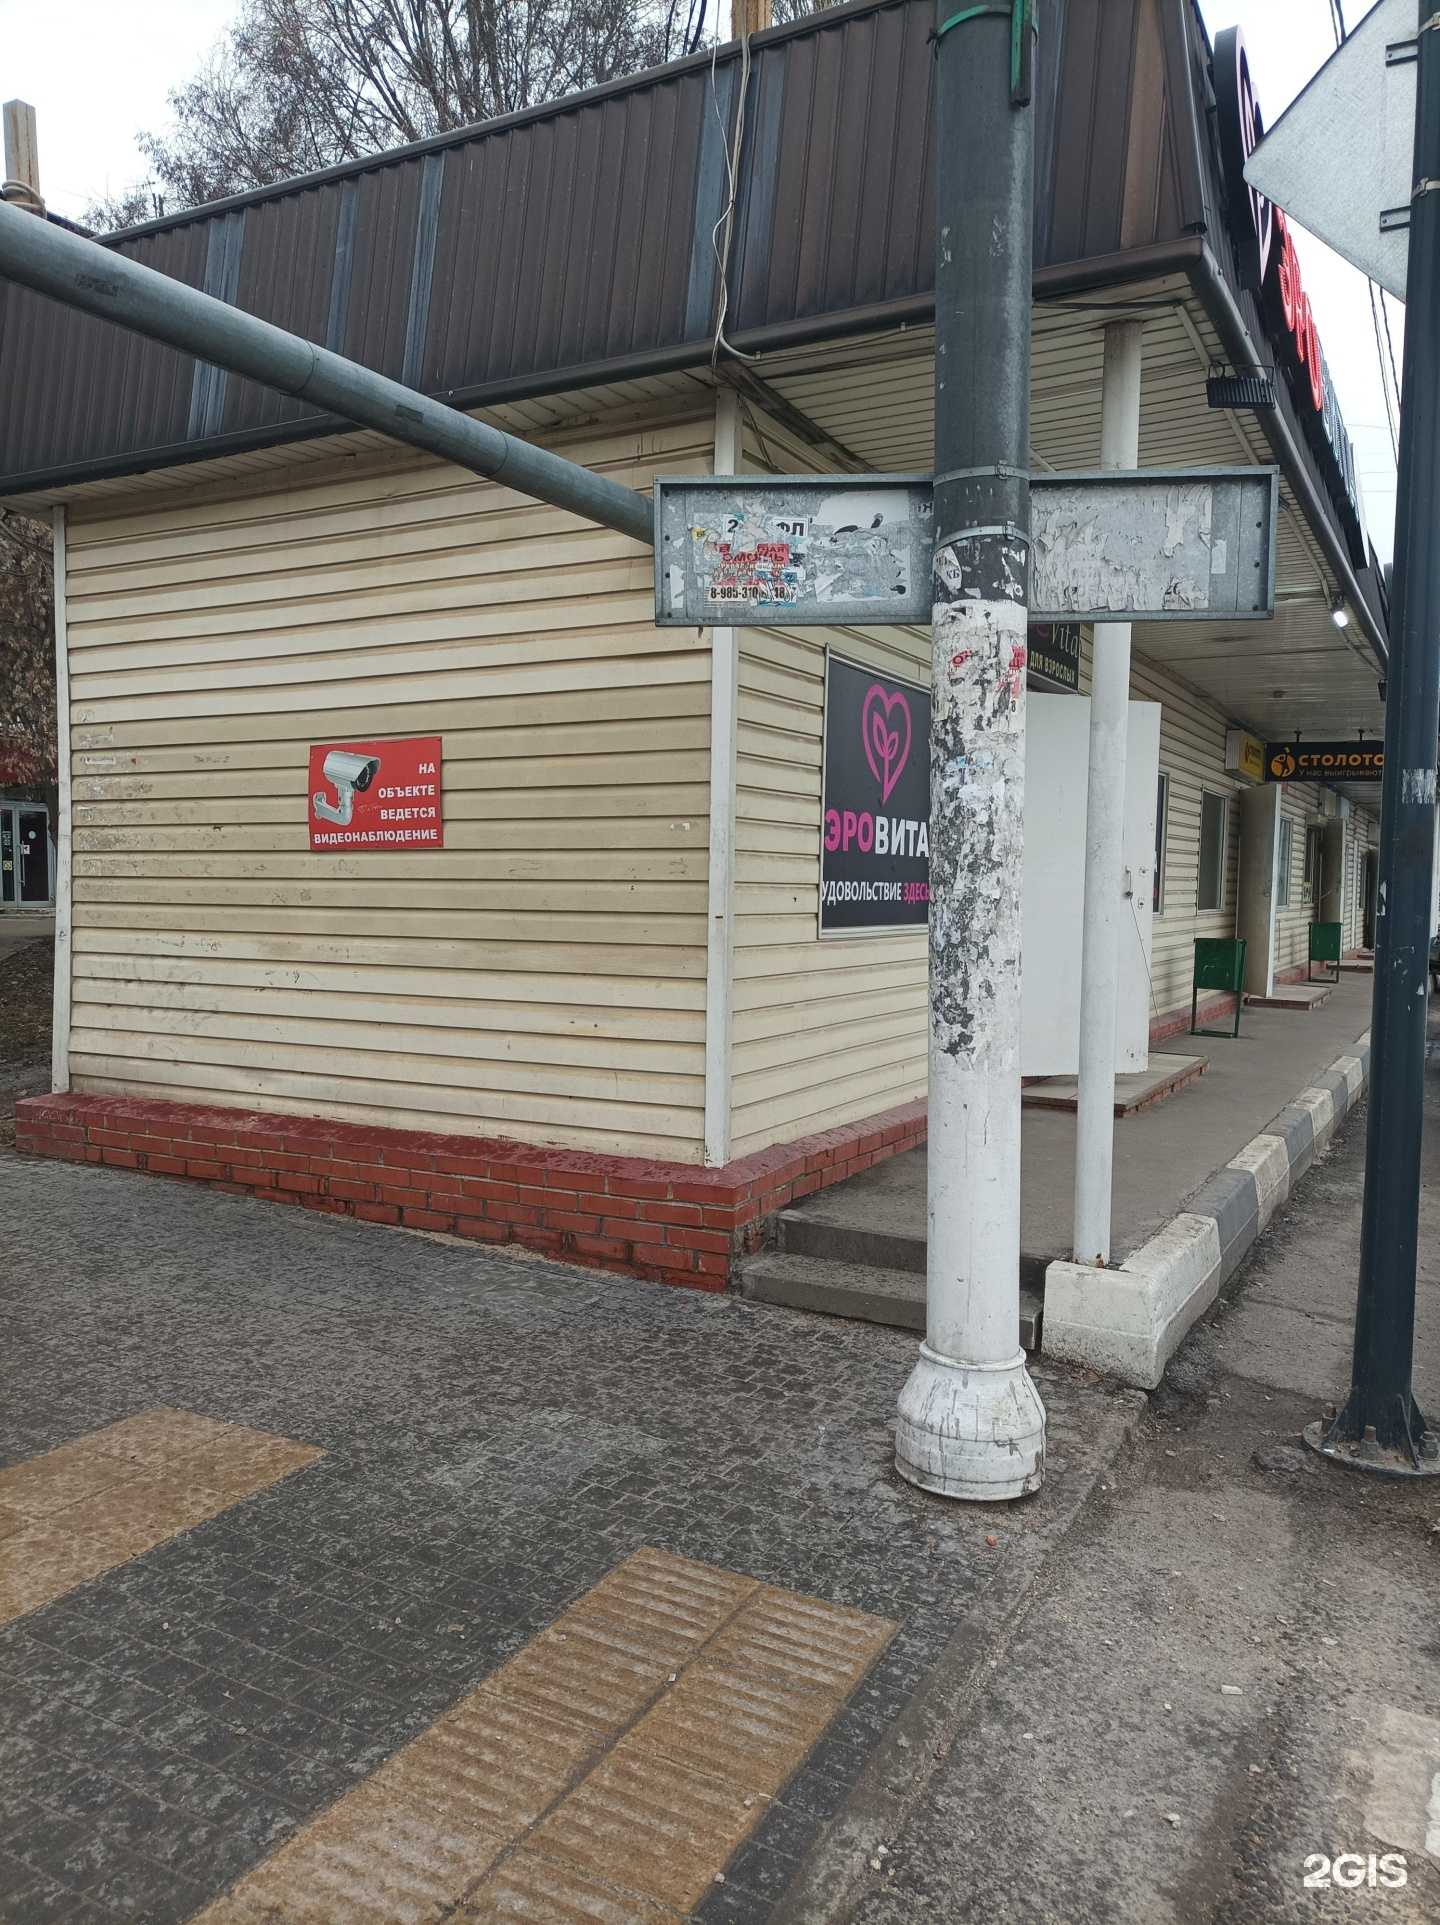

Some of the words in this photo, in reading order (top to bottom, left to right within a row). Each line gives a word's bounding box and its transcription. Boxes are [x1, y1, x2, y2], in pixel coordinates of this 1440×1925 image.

[418, 763, 435, 774] НА
[378, 785, 435, 798] ОБЪЕКТЕ
[380, 808, 436, 821] ВЕДЕТСЯ
[314, 829, 438, 844] ВИДЕОНАБЛЮДЕНИЕ
[825, 809, 929, 857] ЭРОВИТА
[822, 880, 902, 905] УДОВОЛЬСТВИЕ
